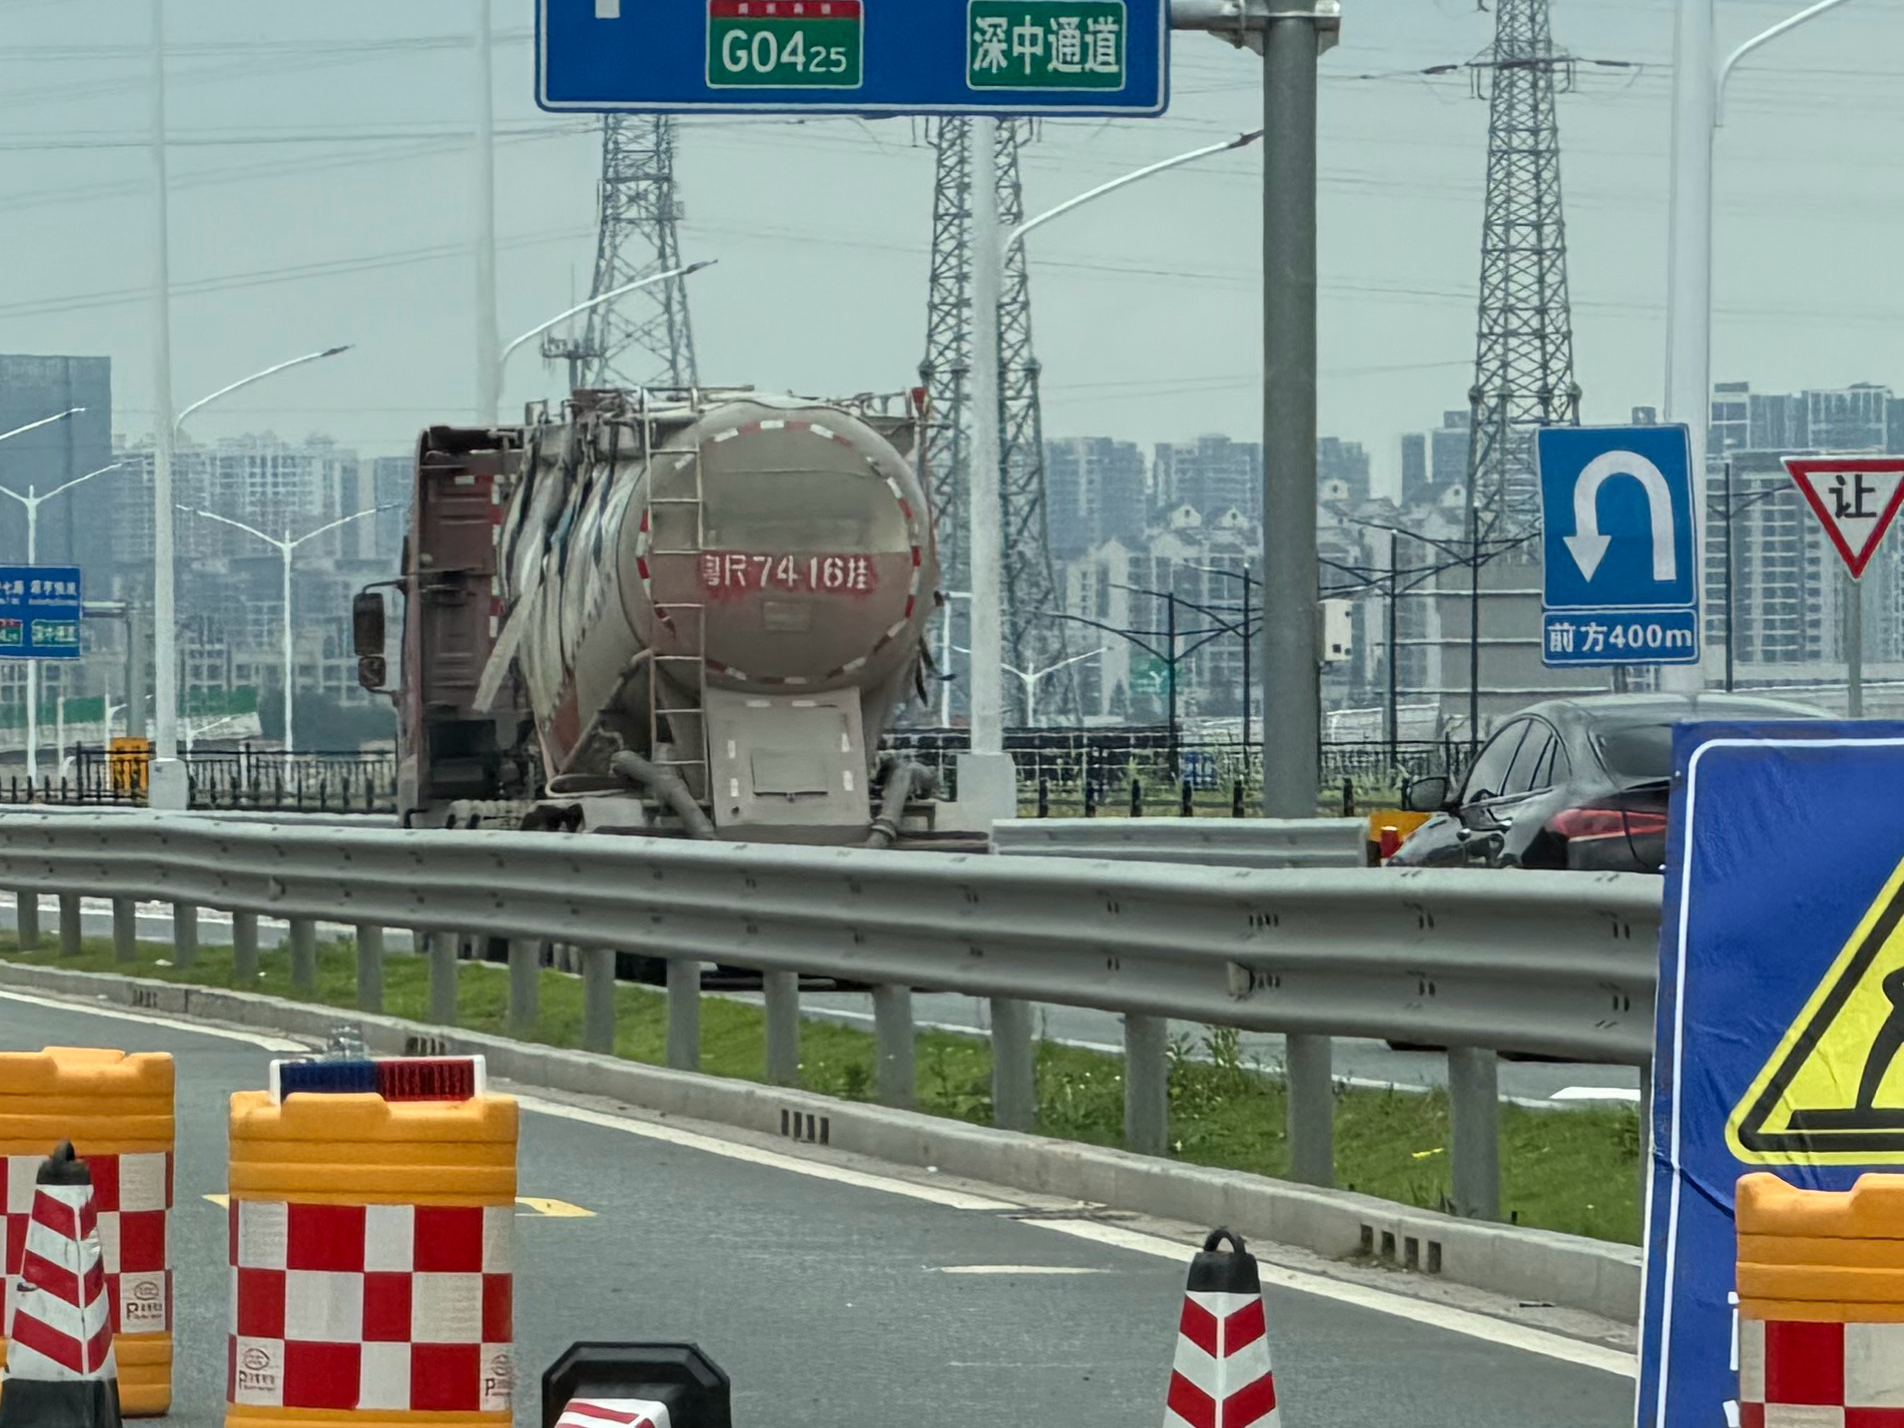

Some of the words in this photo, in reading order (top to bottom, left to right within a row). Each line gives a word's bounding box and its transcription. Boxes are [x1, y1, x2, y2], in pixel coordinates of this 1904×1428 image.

[973, 15, 1121, 76] 深中通道
[1828, 474, 1877, 519] 让
[1547, 623, 1693, 653] 前方400m
